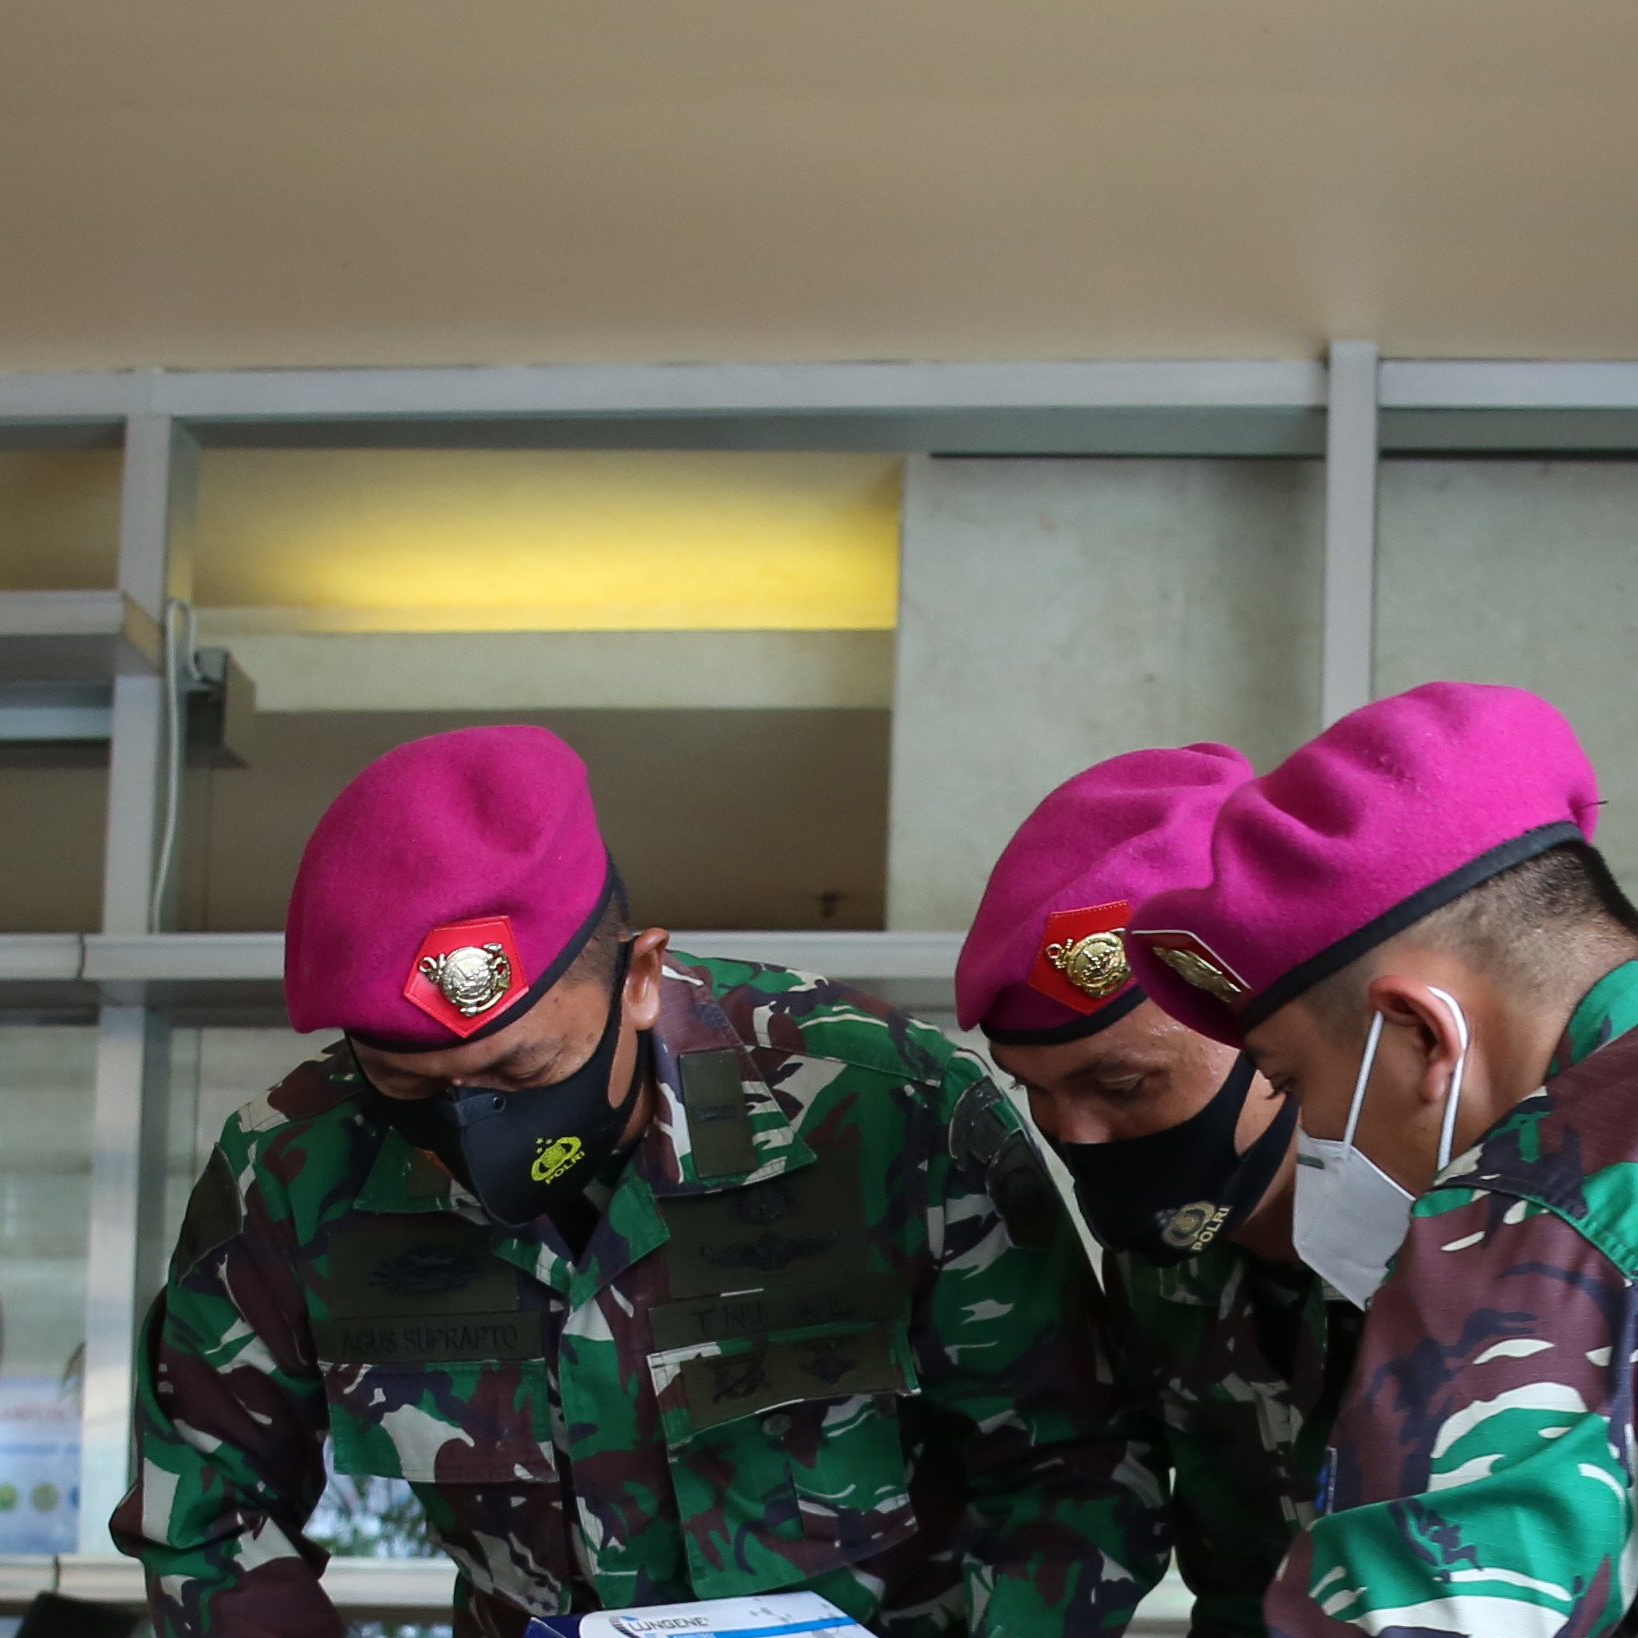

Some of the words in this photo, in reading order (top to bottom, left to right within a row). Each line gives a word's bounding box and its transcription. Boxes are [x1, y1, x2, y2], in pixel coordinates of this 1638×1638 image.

[1191, 1206, 1231, 1251] POLRI
[342, 1328, 396, 1356] AGUS
[403, 1324, 519, 1352] SUPRAPTO
